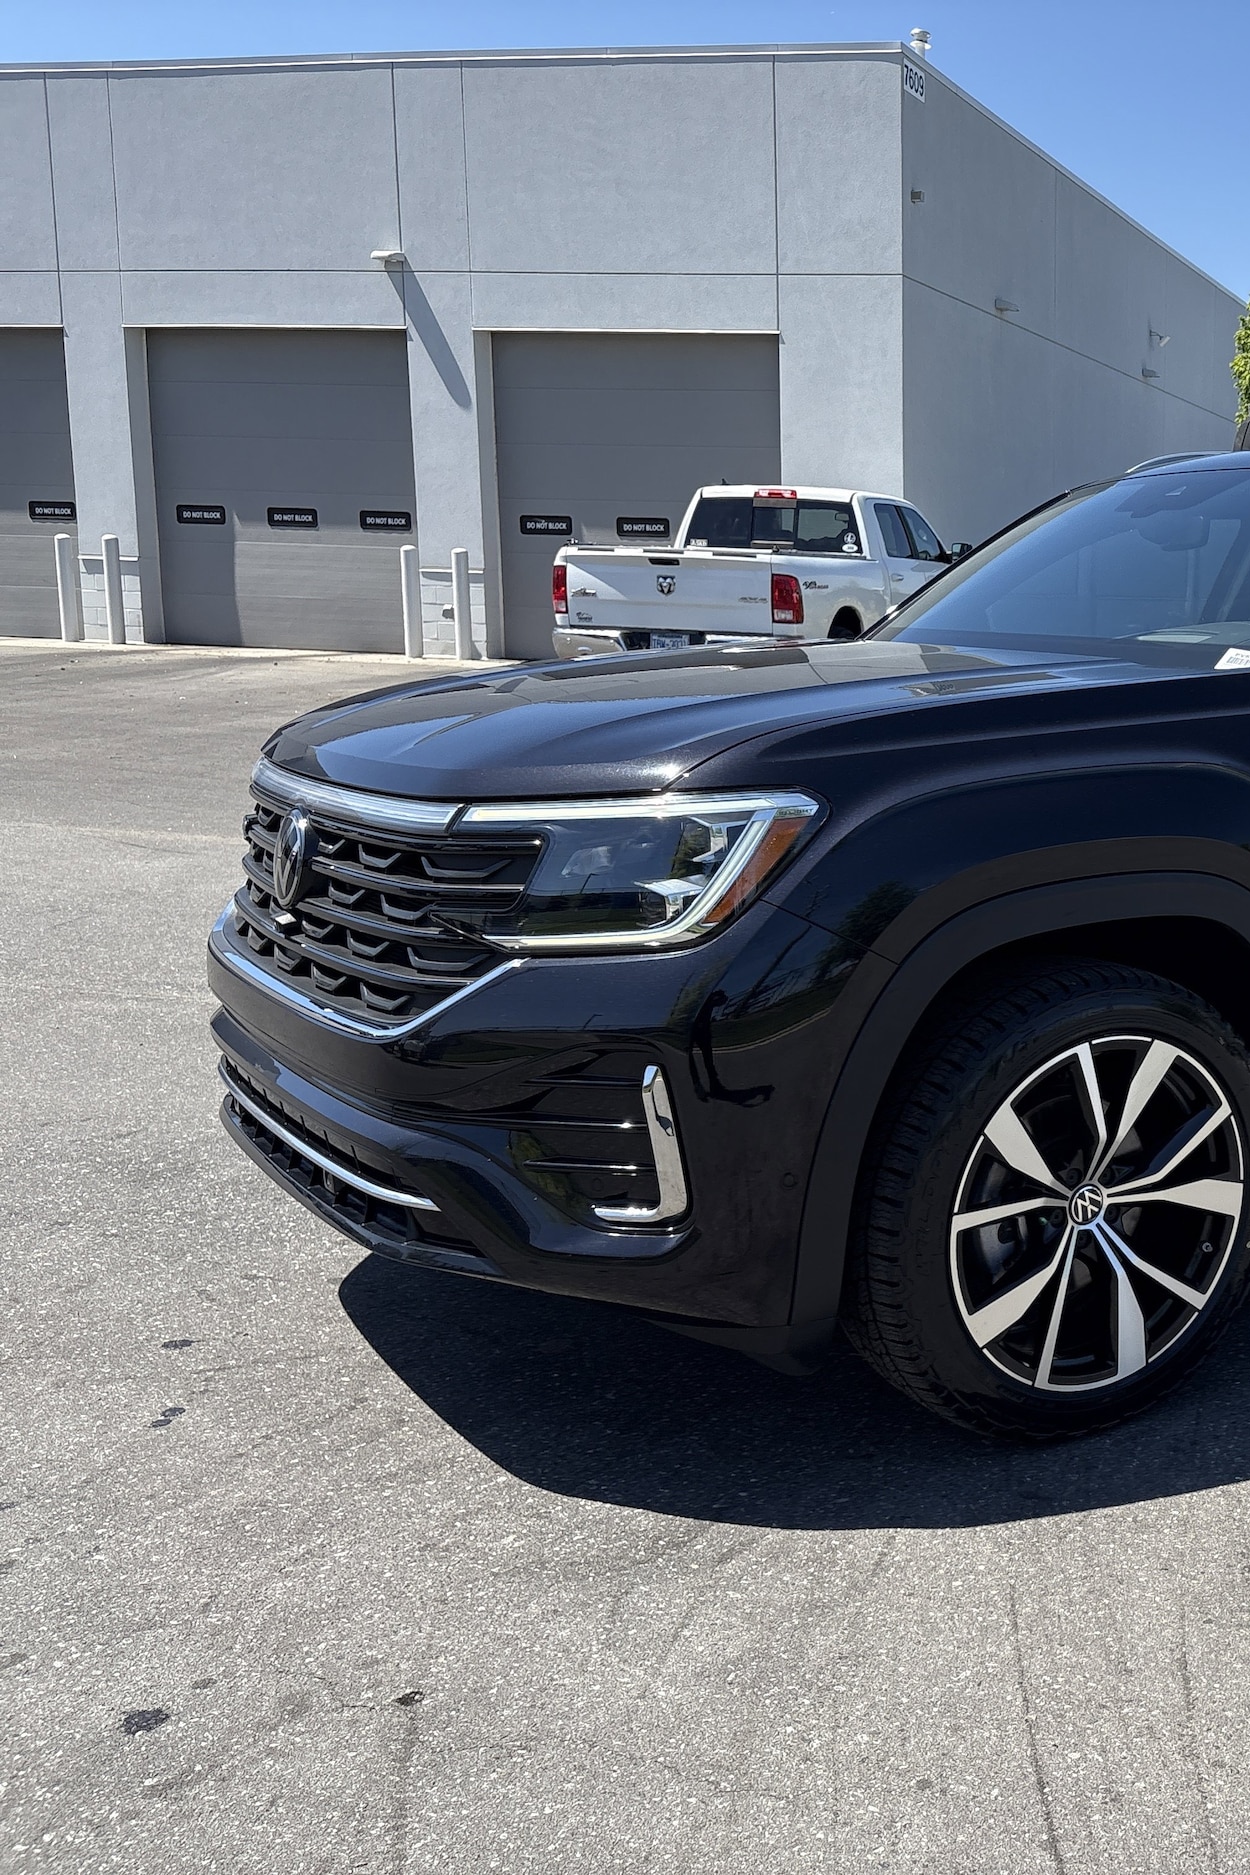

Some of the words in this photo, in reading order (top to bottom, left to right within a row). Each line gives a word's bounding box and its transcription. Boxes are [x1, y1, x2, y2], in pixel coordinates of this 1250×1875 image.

[904, 64, 924, 97] 7609
[44, 507, 54, 515] NOT
[192, 511, 202, 519] NOT
[203, 511, 221, 519] BLOCK
[274, 513, 282, 521] DO
[295, 514, 313, 522] BLOCK
[366, 516, 375, 524] DO
[376, 517, 387, 525] NOT
[388, 517, 407, 525] BLOCK
[527, 521, 535, 529] DO
[536, 522, 547, 530] NOT
[548, 522, 567, 530] BLOCK
[623, 523, 632, 531] DO
[646, 524, 665, 532] BLOCK
